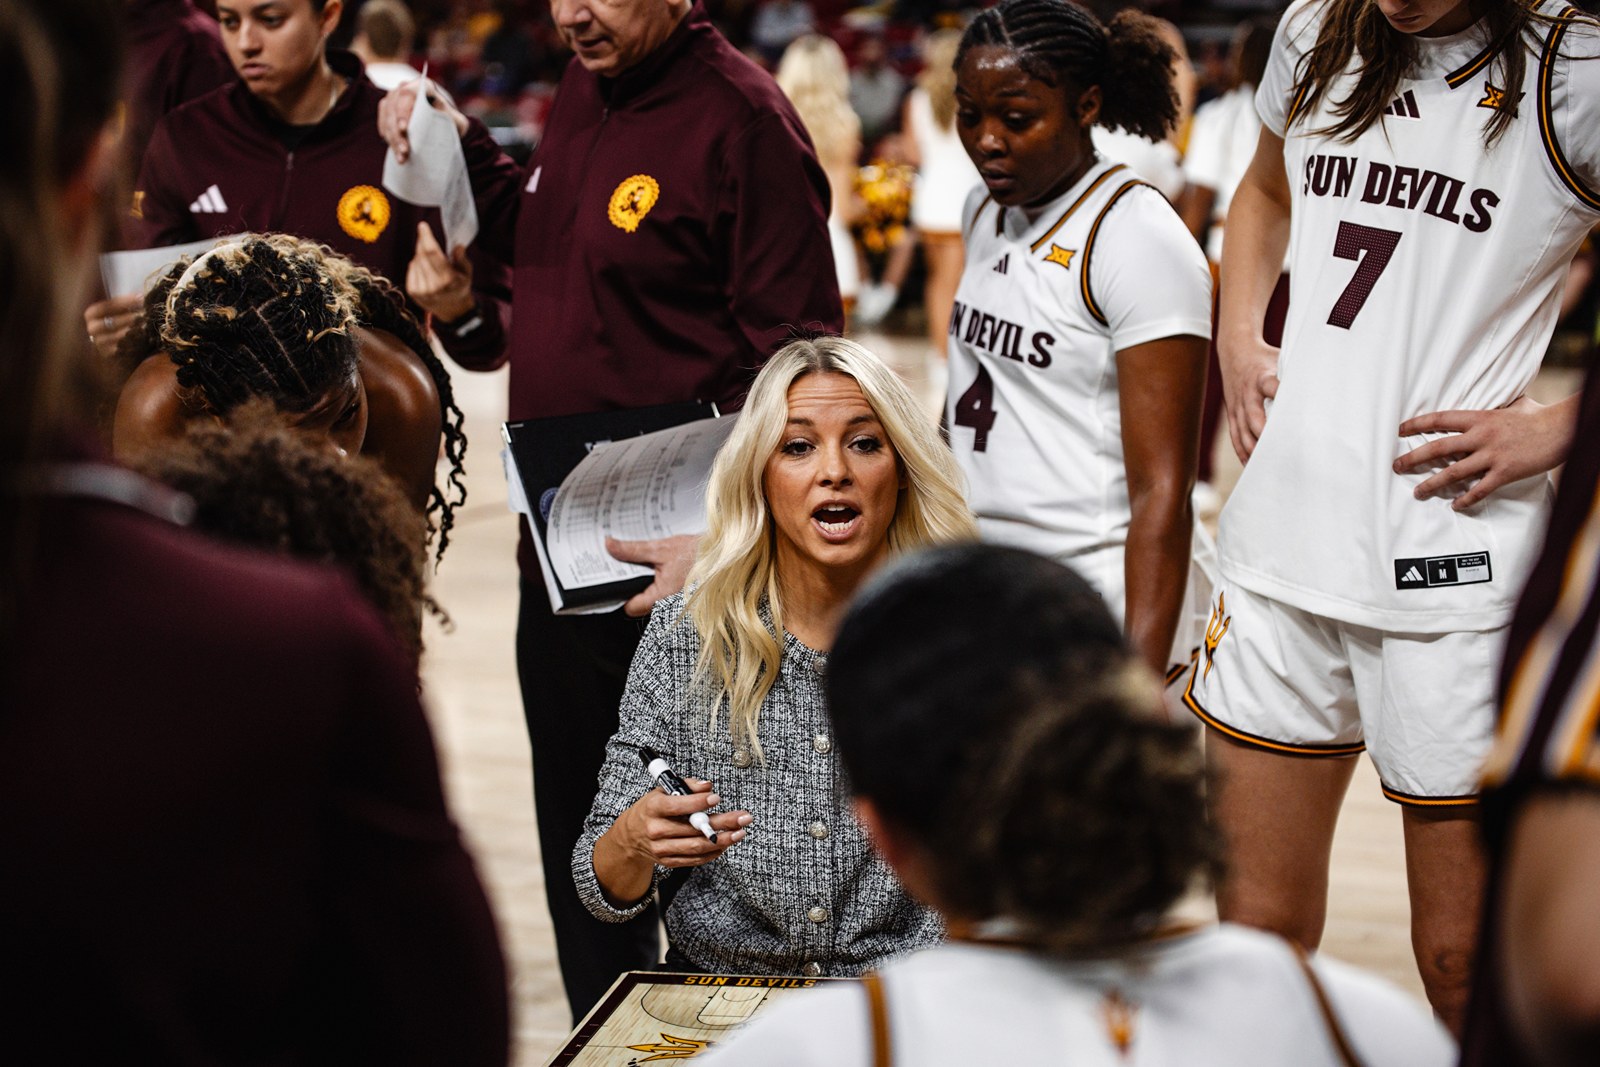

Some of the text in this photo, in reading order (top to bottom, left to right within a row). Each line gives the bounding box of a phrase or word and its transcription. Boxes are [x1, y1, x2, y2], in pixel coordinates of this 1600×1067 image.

[1304, 154, 1500, 233] SUN DEVILS
[1327, 220, 1403, 330] 7
[965, 308, 1056, 369] DEVILS
[954, 362, 998, 453] 4
[1438, 568, 1448, 580] M
[684, 976, 816, 988] SUN DEVILS
